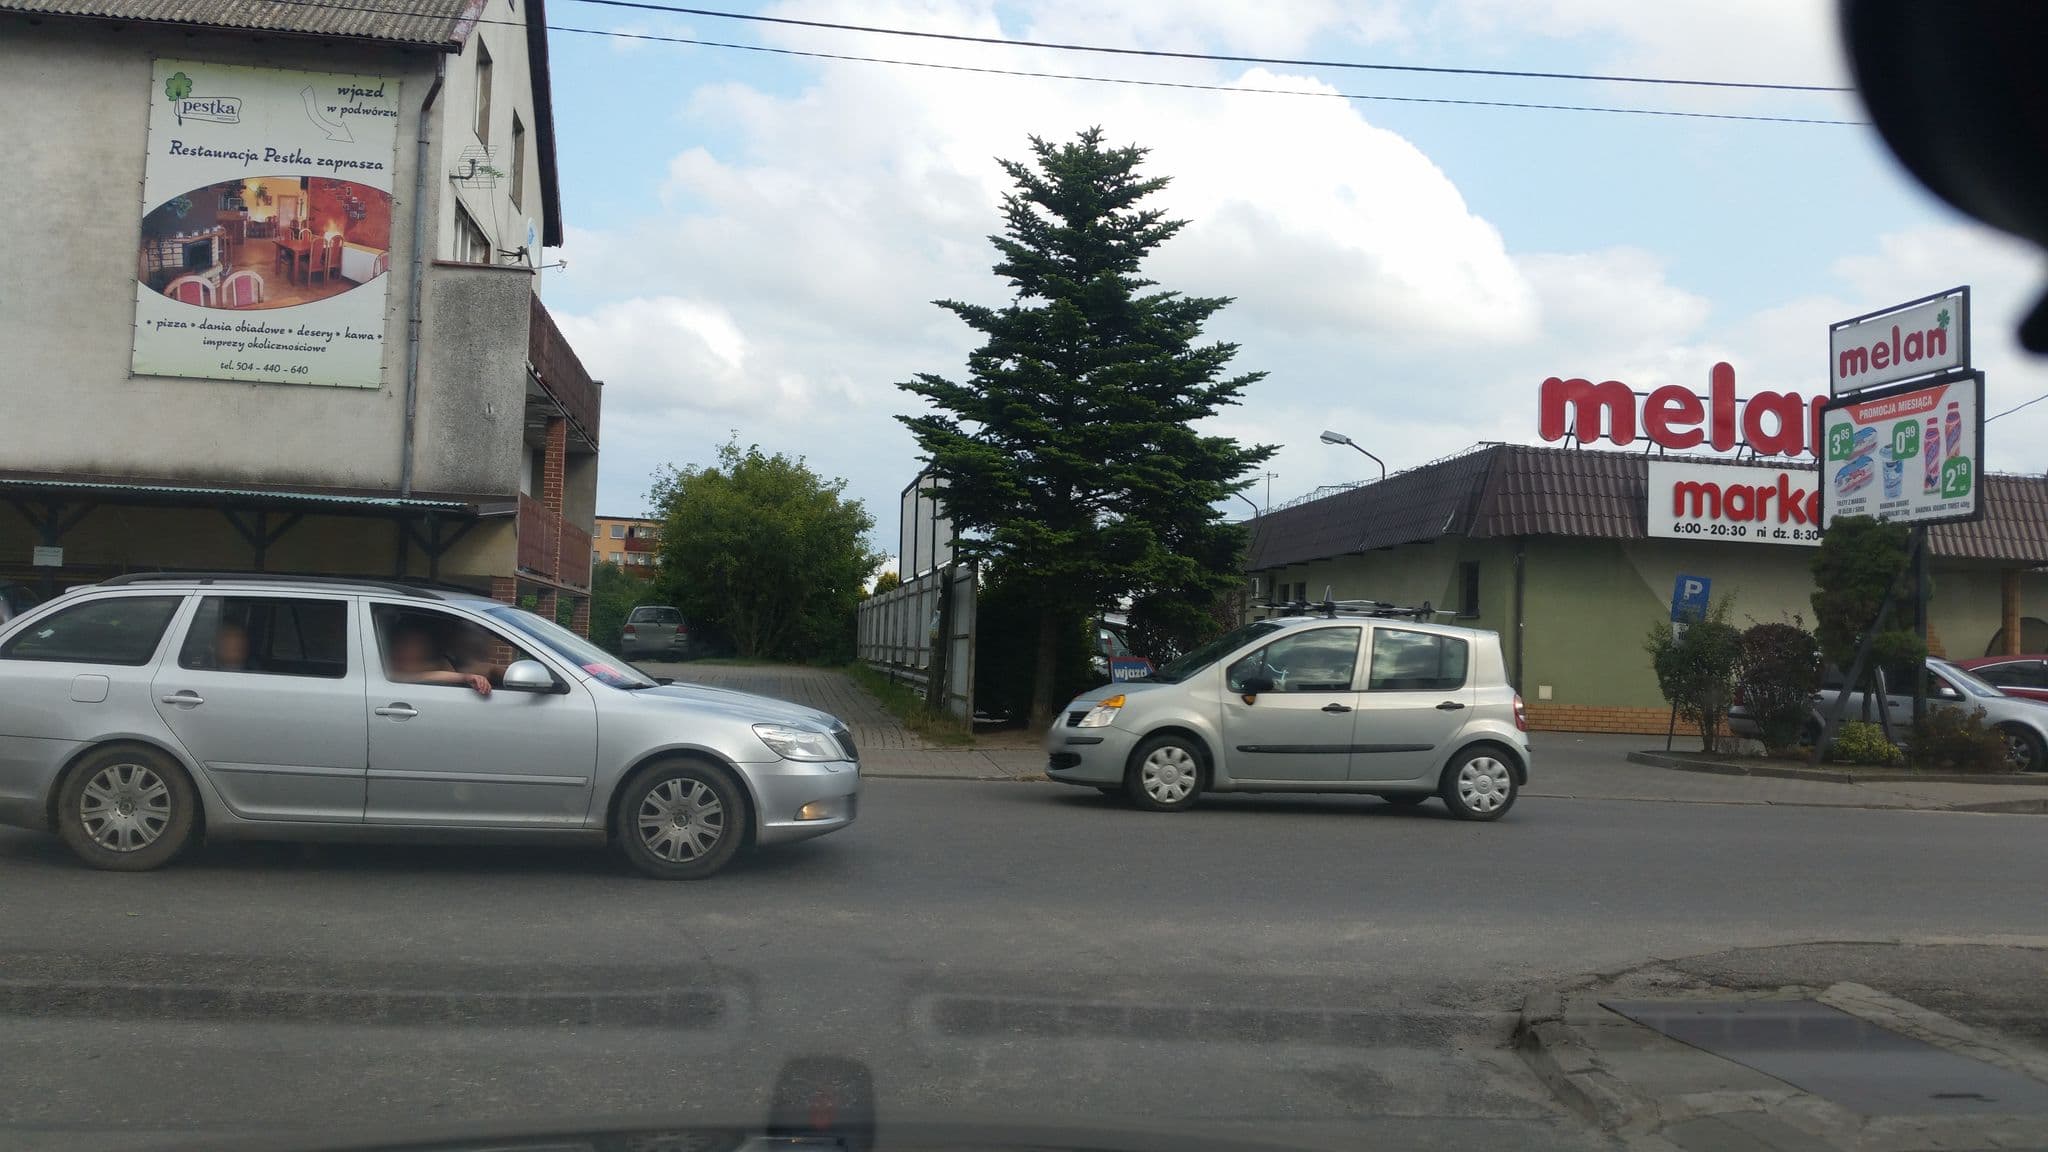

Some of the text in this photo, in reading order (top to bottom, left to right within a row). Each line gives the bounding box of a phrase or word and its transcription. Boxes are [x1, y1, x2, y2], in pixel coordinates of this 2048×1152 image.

[337, 82, 385, 103] wjazd
[182, 99, 237, 116] pestka
[326, 102, 398, 119] w podwórzu
[169, 140, 384, 173] Restauracja Pestka zaprasza
[156, 317, 375, 342] pizza dania obiadowe desery kawa
[203, 336, 327, 353] imprezy okolicznościowe
[1839, 324, 1948, 379] melan
[220, 361, 234, 371] tel.
[236, 361, 254, 372] 504
[263, 362, 281, 373] 440
[290, 364, 309, 375] 640
[1859, 396, 1932, 419] PROMOCJA MIESIĄCA
[1673, 522, 1701, 534] 6:00
[1710, 524, 1747, 537] 20:30
[1756, 526, 1767, 538] ni
[1772, 527, 1790, 539] dz.
[1683, 579, 1703, 600] P
[1114, 666, 1147, 680] wjazd
